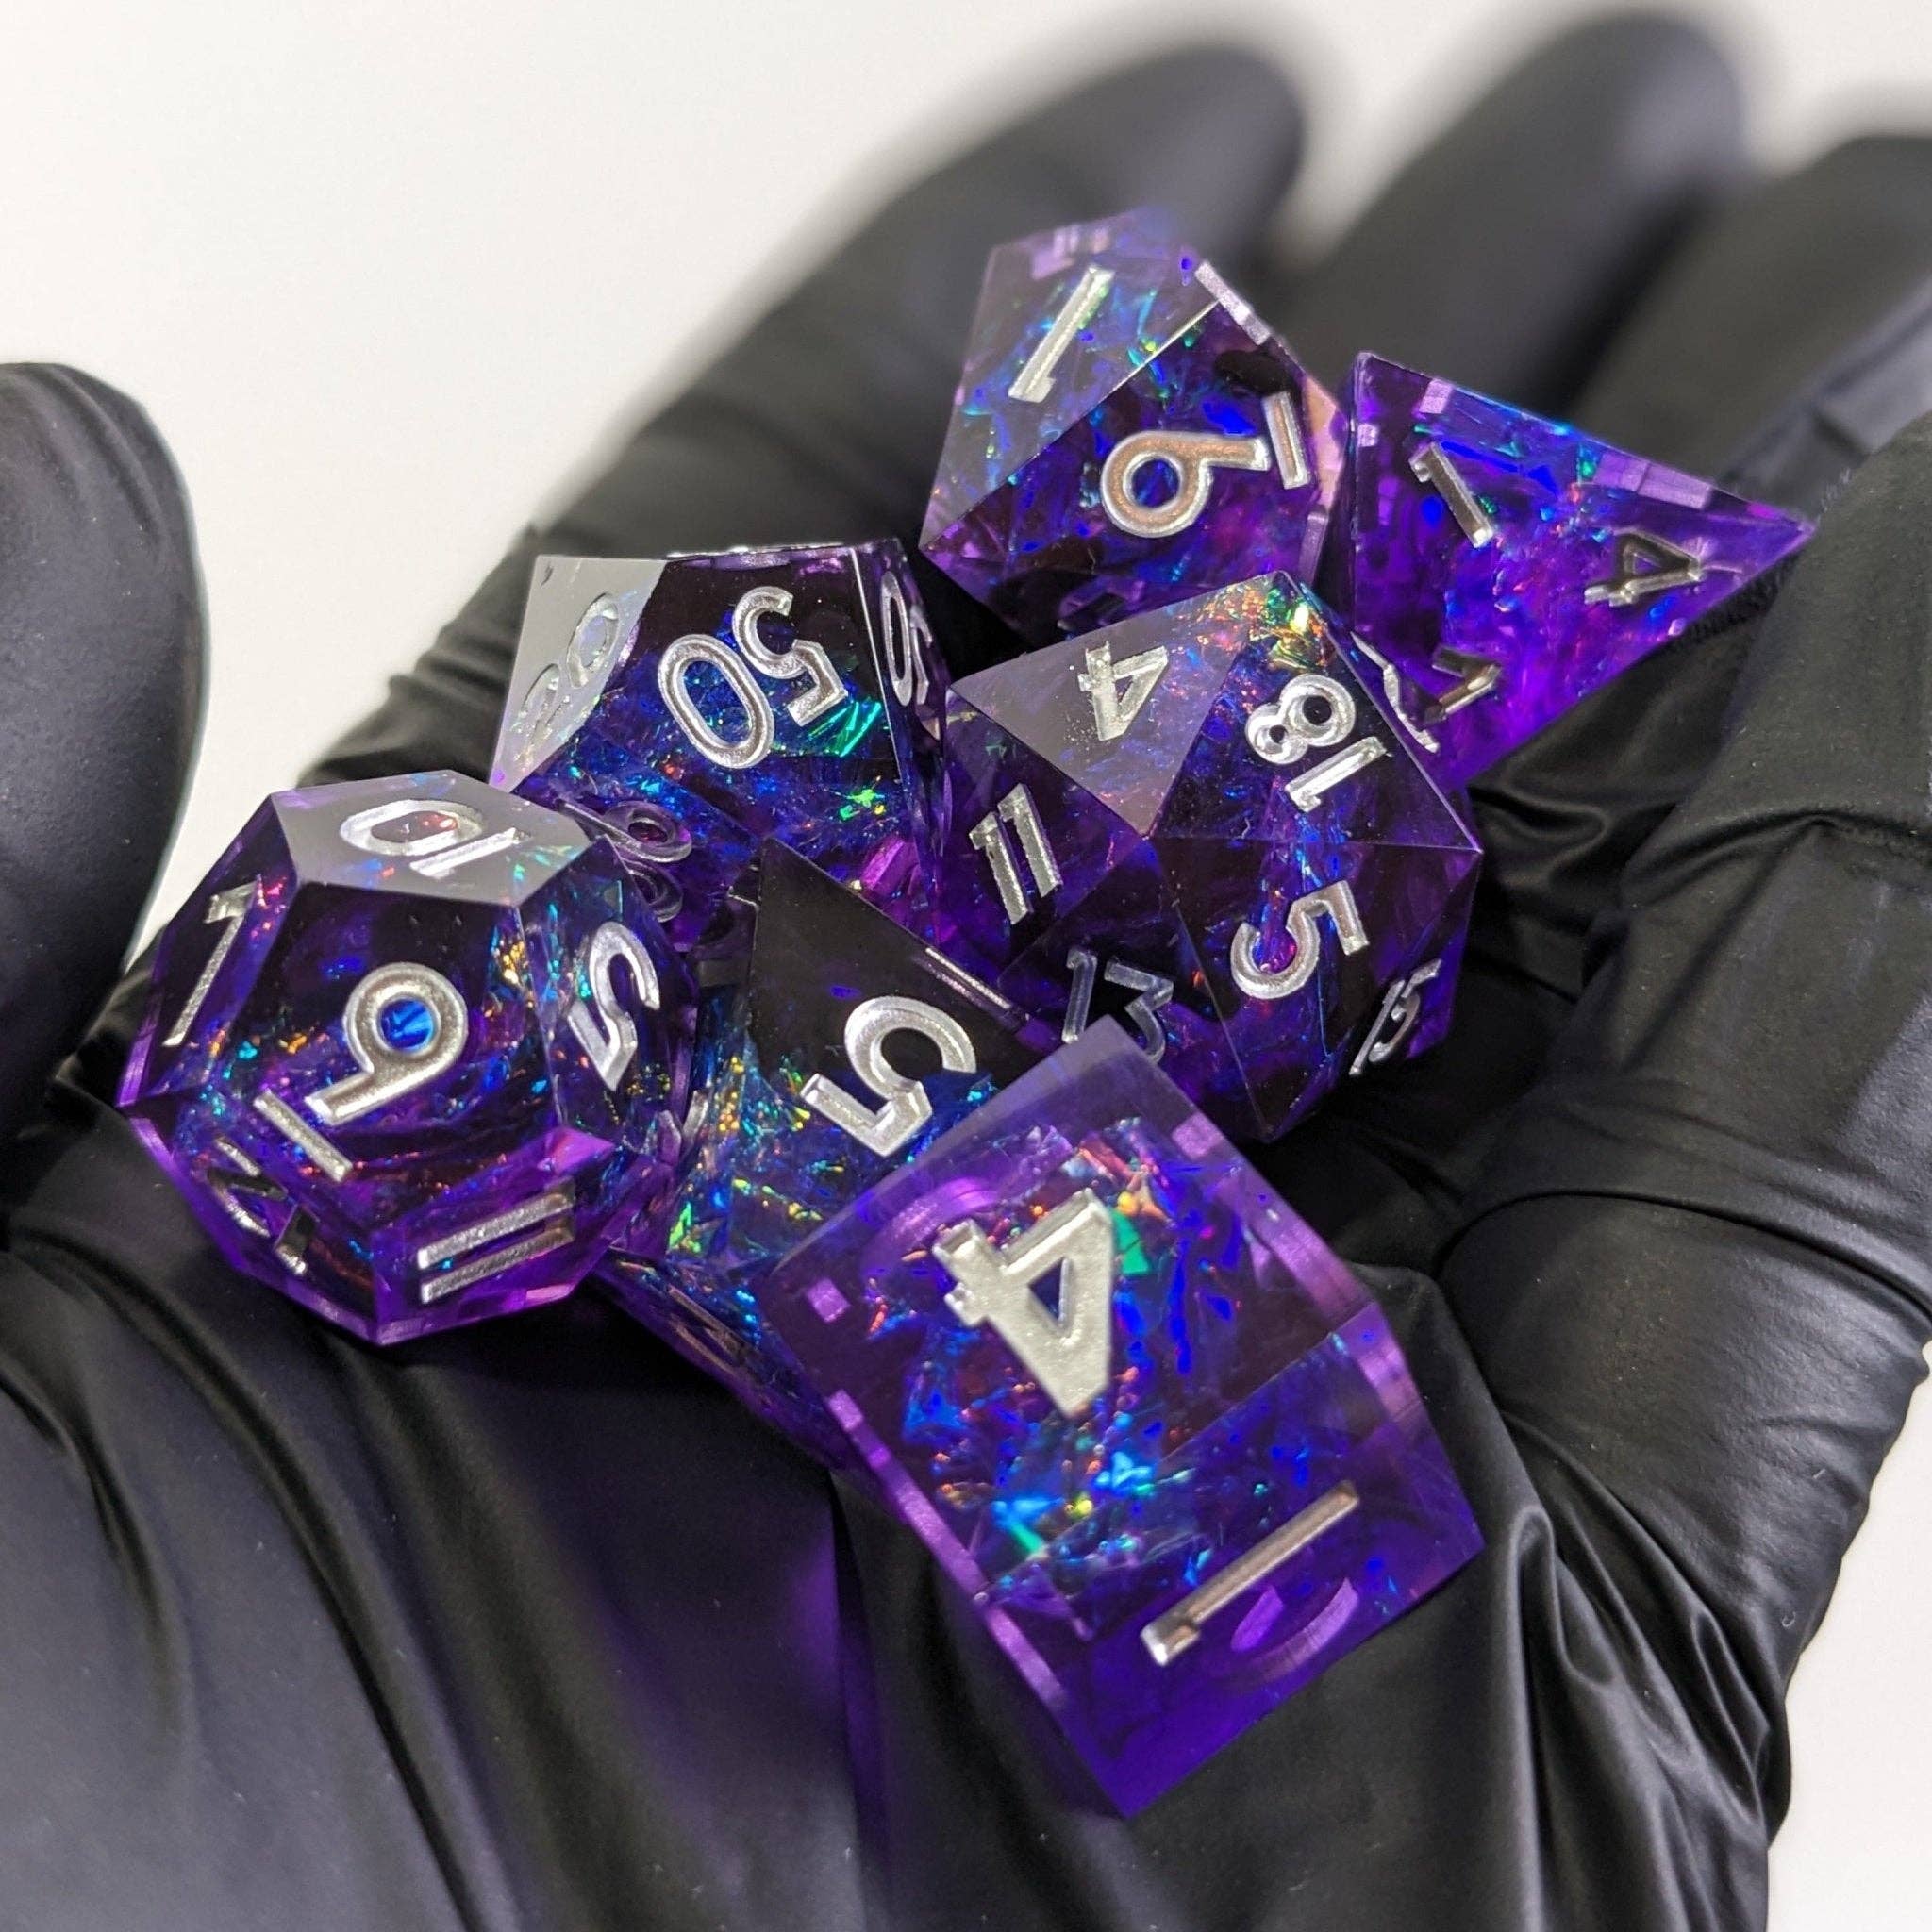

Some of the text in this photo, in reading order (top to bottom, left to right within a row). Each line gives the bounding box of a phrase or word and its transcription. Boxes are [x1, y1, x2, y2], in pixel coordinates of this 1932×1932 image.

[1008, 263, 1115, 402] 1
[1409, 441, 1494, 548] 1
[1584, 526, 1706, 608] 4
[658, 586, 849, 769] 50
[1077, 641, 1169, 741] 4
[1245, 673, 1388, 812] 18
[340, 799, 530, 879] 10
[969, 784, 1063, 924] 11
[1061, 946, 1174, 1064] 13
[1230, 880, 1369, 1000] 5
[800, 995, 977, 1157] 5
[417, 1177, 576, 1304] 11
[932, 1188, 1112, 1418] 4
[1141, 1480, 1360, 1666] 1
